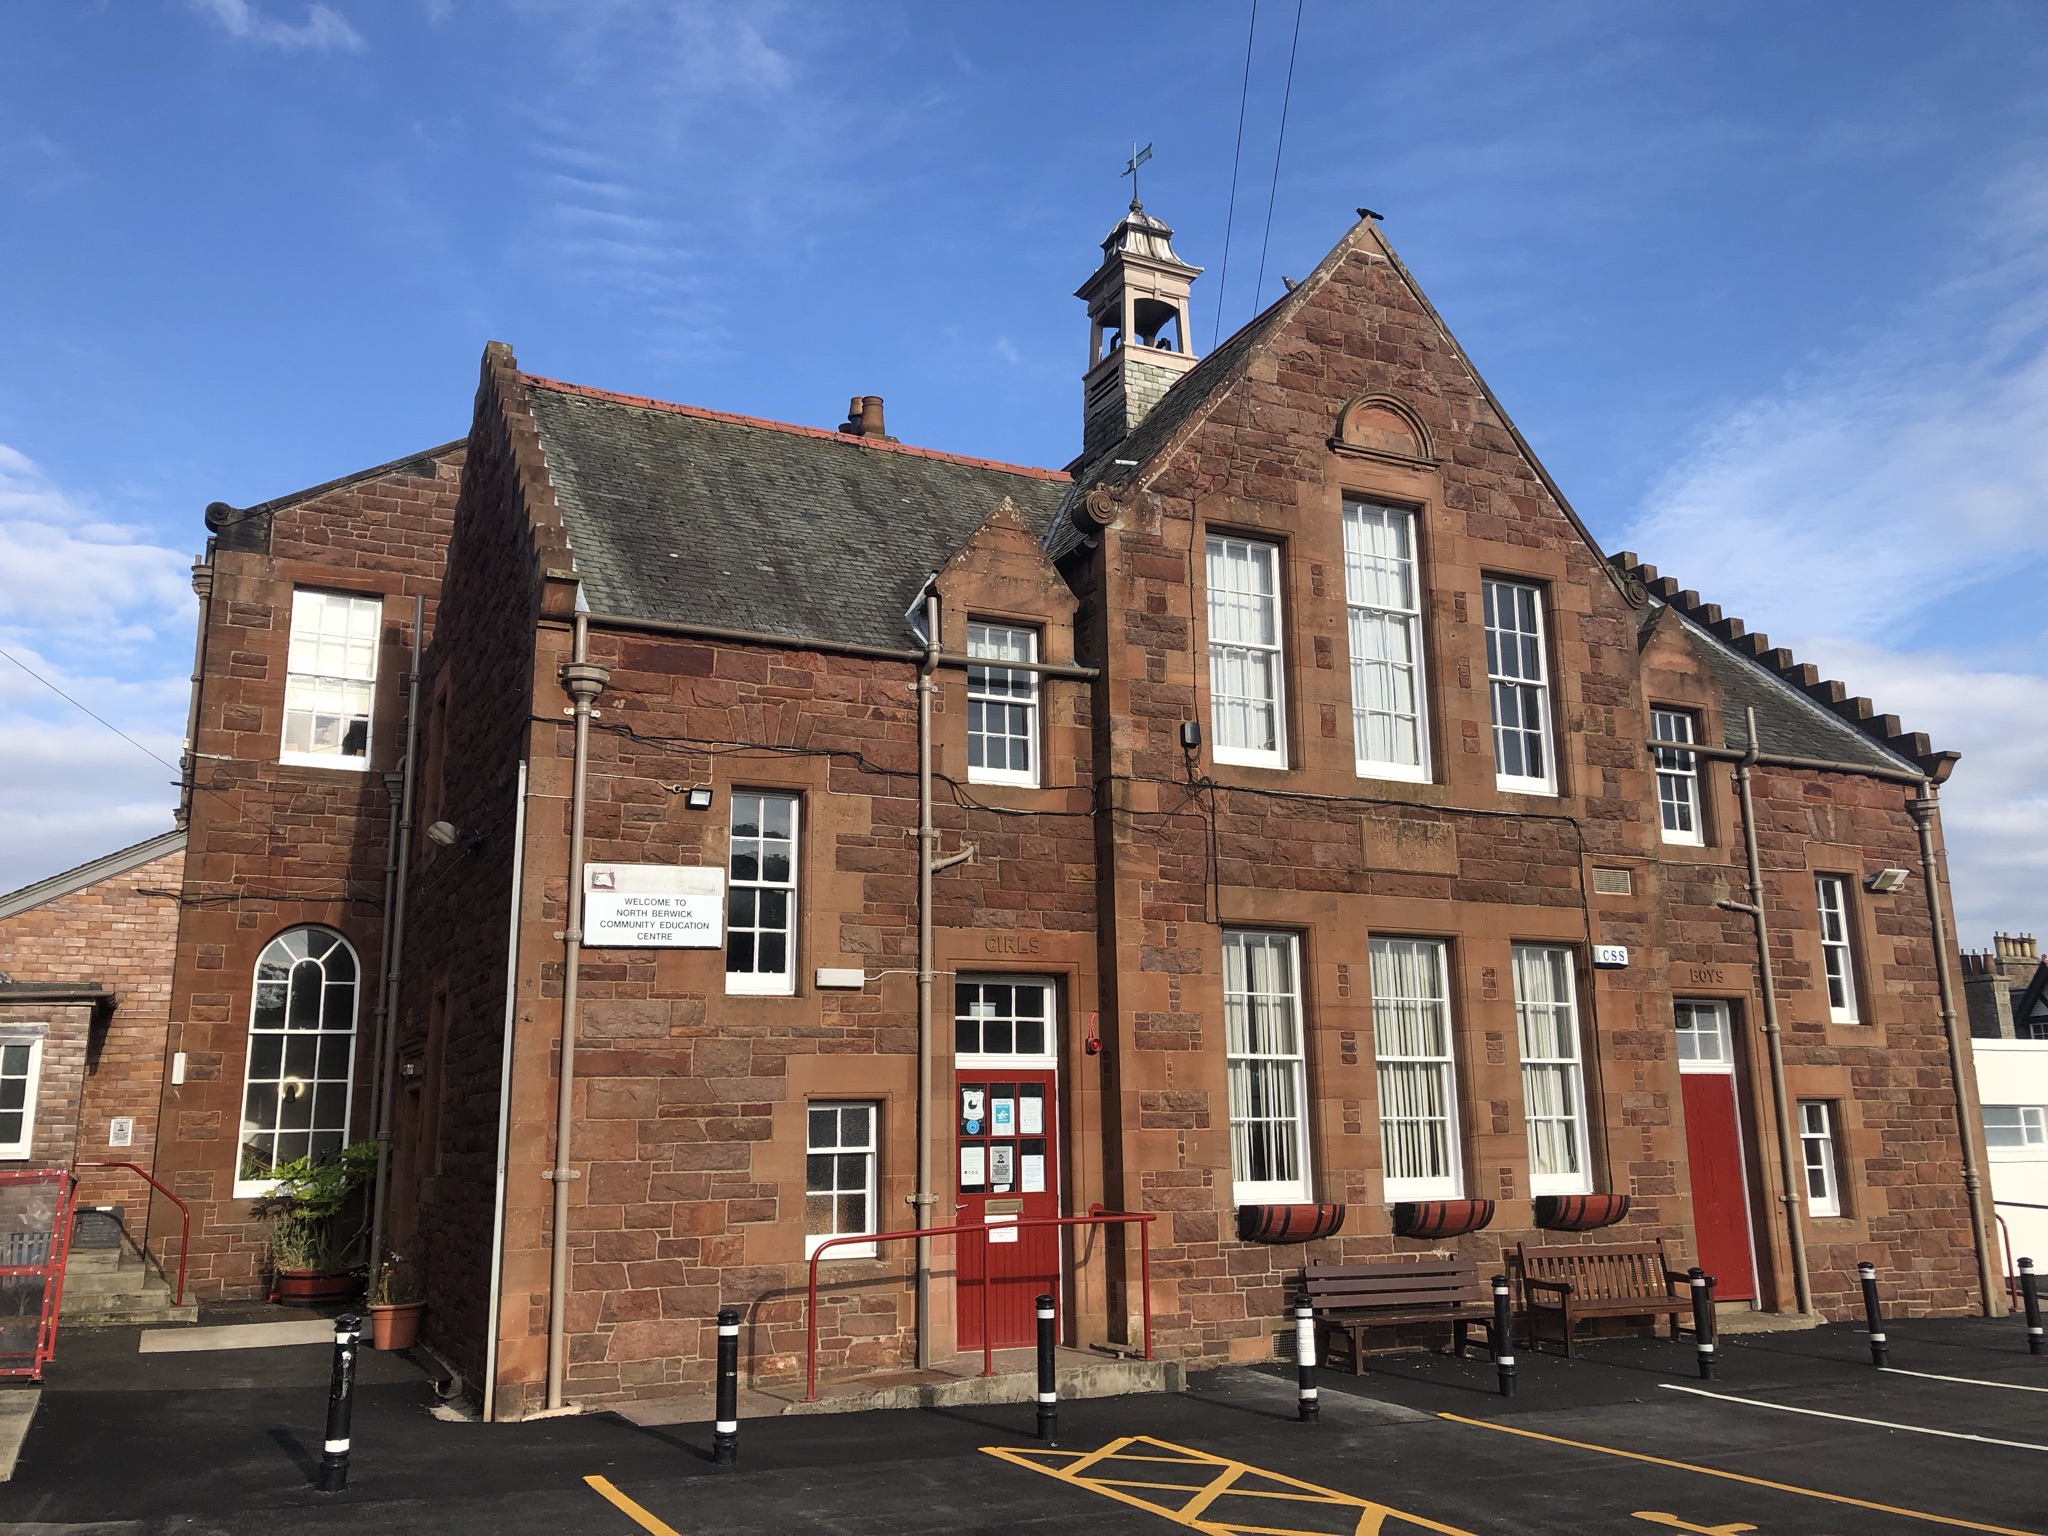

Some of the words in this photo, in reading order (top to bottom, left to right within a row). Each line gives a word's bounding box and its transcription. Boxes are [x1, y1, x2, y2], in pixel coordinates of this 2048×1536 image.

[1371, 831, 1400, 846] HIGH
[1404, 833, 1450, 848] SCHOOL
[624, 897, 671, 907] WELCOME
[674, 898, 687, 907] TO
[616, 909, 648, 918] NORTH
[651, 910, 693, 919] BERWICK
[599, 920, 656, 930] COMMUNITY
[659, 921, 710, 930] EDUCATION
[636, 932, 673, 941] CENTRE
[984, 936, 1040, 954] GIRLS
[1602, 949, 1625, 962] CSS
[1689, 968, 1724, 984] BOYS
